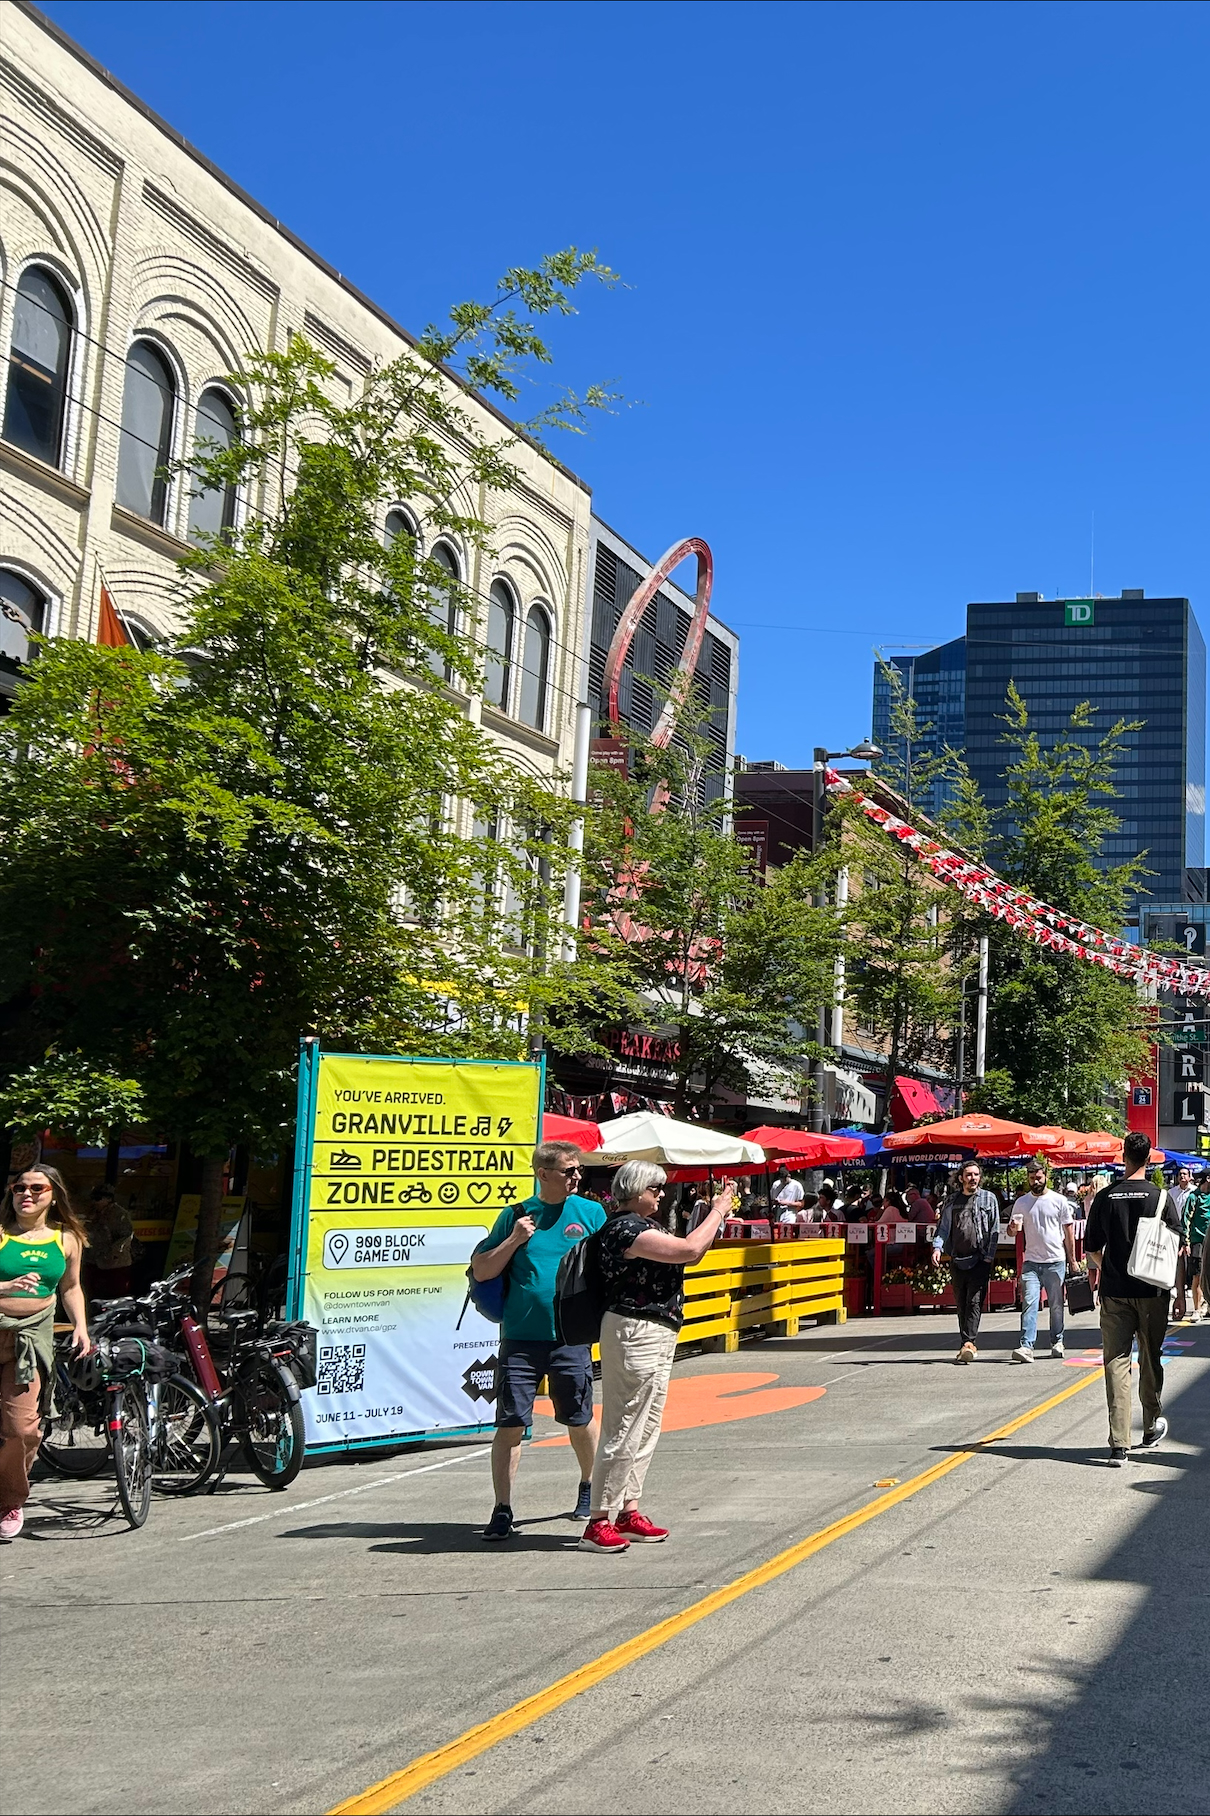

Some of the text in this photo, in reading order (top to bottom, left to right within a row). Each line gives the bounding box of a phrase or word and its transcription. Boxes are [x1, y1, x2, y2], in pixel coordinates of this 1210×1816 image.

[1067, 605, 1091, 621] TD
[609, 757, 624, 765] 8pm
[334, 1090, 446, 1105] YOU'VE ARRIVED.
[332, 1112, 467, 1136] GRANVILLE
[372, 1150, 514, 1171] PEDESTRIAN
[843, 1158, 866, 1167] ULTRA
[892, 1154, 908, 1163] FIFA
[908, 1154, 933, 1162] WORLD
[934, 1154, 948, 1162] CUP
[327, 1182, 396, 1204] ZONE
[355, 1234, 426, 1248] 900 BLOCK
[20, 1250, 48, 1259] BRASIL
[354, 1249, 410, 1263] GAME ON
[324, 1286, 442, 1299] FOLLOW US FOR MORE FUN!
[324, 1300, 390, 1310] @downtownvan
[322, 1315, 379, 1324] LEARN MORE
[322, 1324, 397, 1335] www.dtvan.ca/gpz
[453, 1340, 500, 1349] PRESENTED
[470, 1370, 494, 1379] DOWN
[470, 1376, 494, 1384] TOWN
[478, 1381, 493, 1390] VAN
[316, 1412, 341, 1423] JUNE
[343, 1411, 355, 1420] 11
[364, 1408, 388, 1418] JULY
[391, 1406, 403, 1415] 19
